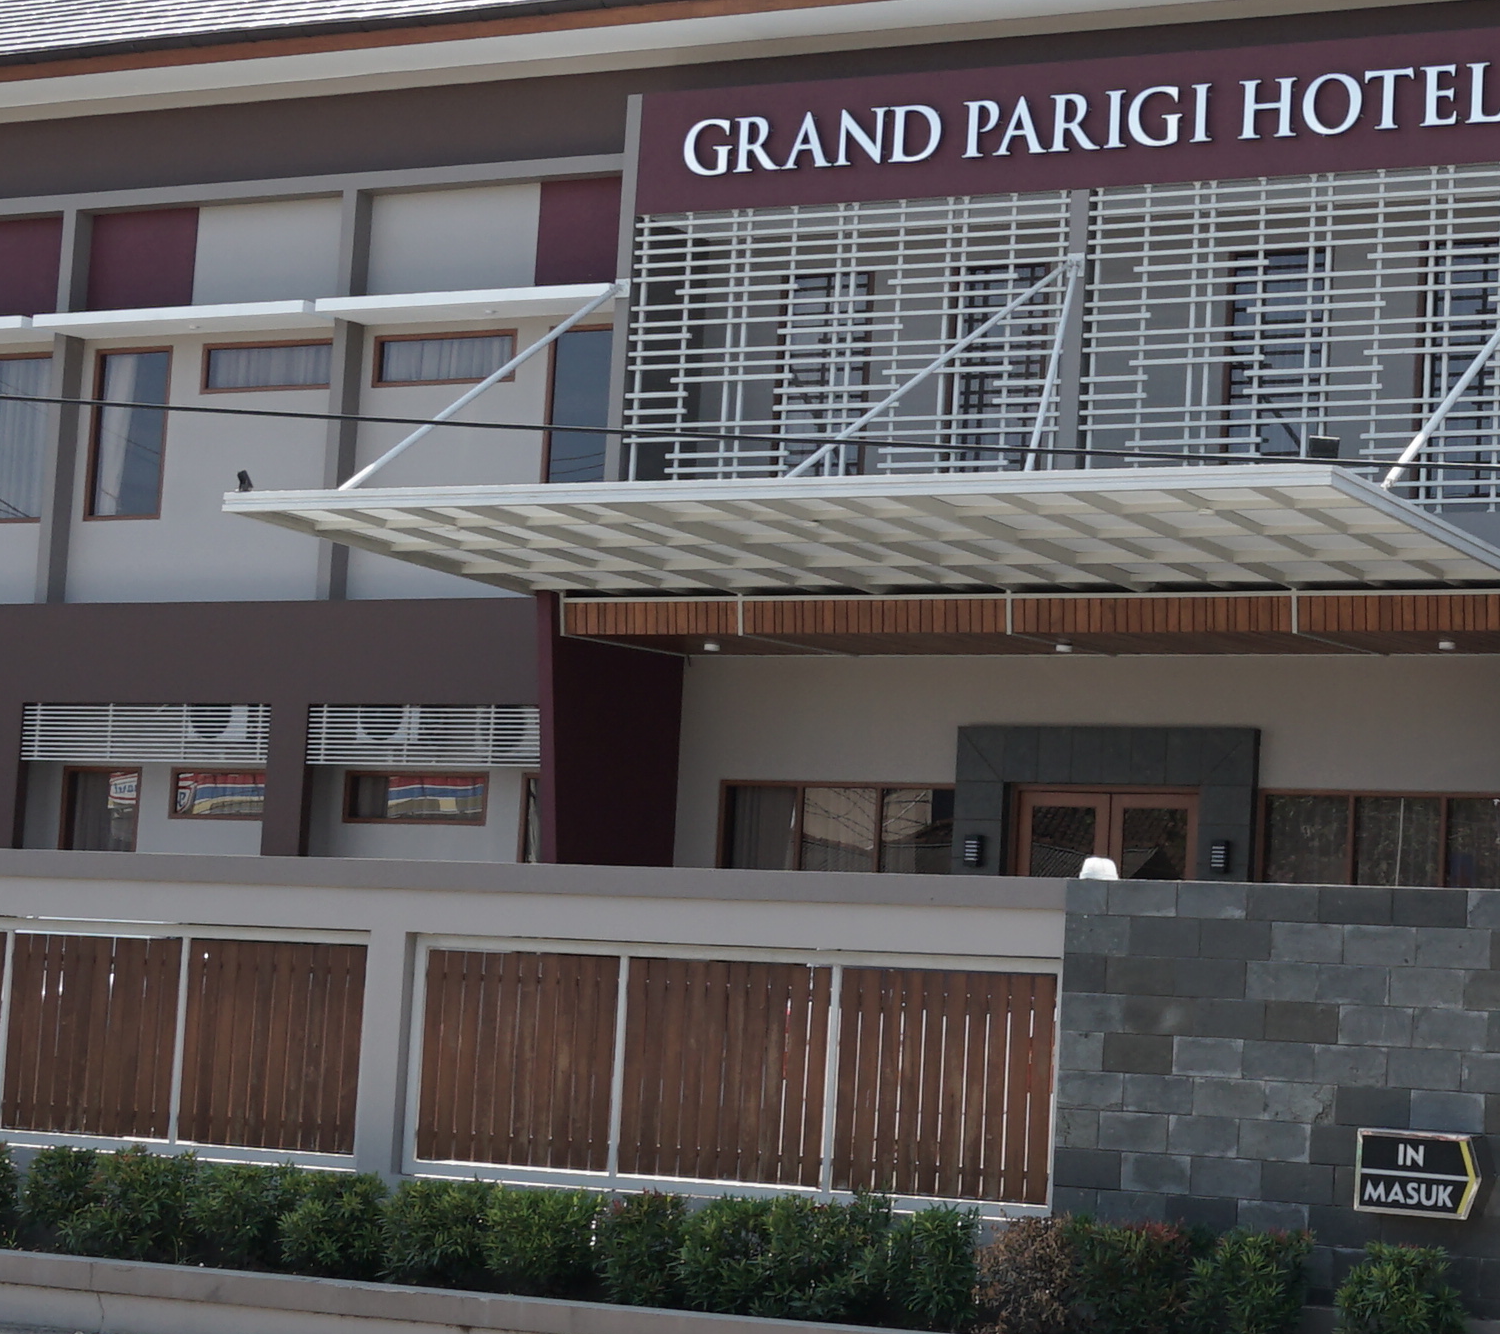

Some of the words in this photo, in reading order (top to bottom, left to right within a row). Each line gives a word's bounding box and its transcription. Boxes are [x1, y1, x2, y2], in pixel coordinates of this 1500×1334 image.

[682, 103, 943, 177] GRAND
[960, 82, 1213, 159] PARIGI
[1397, 1142, 1425, 1168] IN
[1363, 1178, 1454, 1208] MASUK
